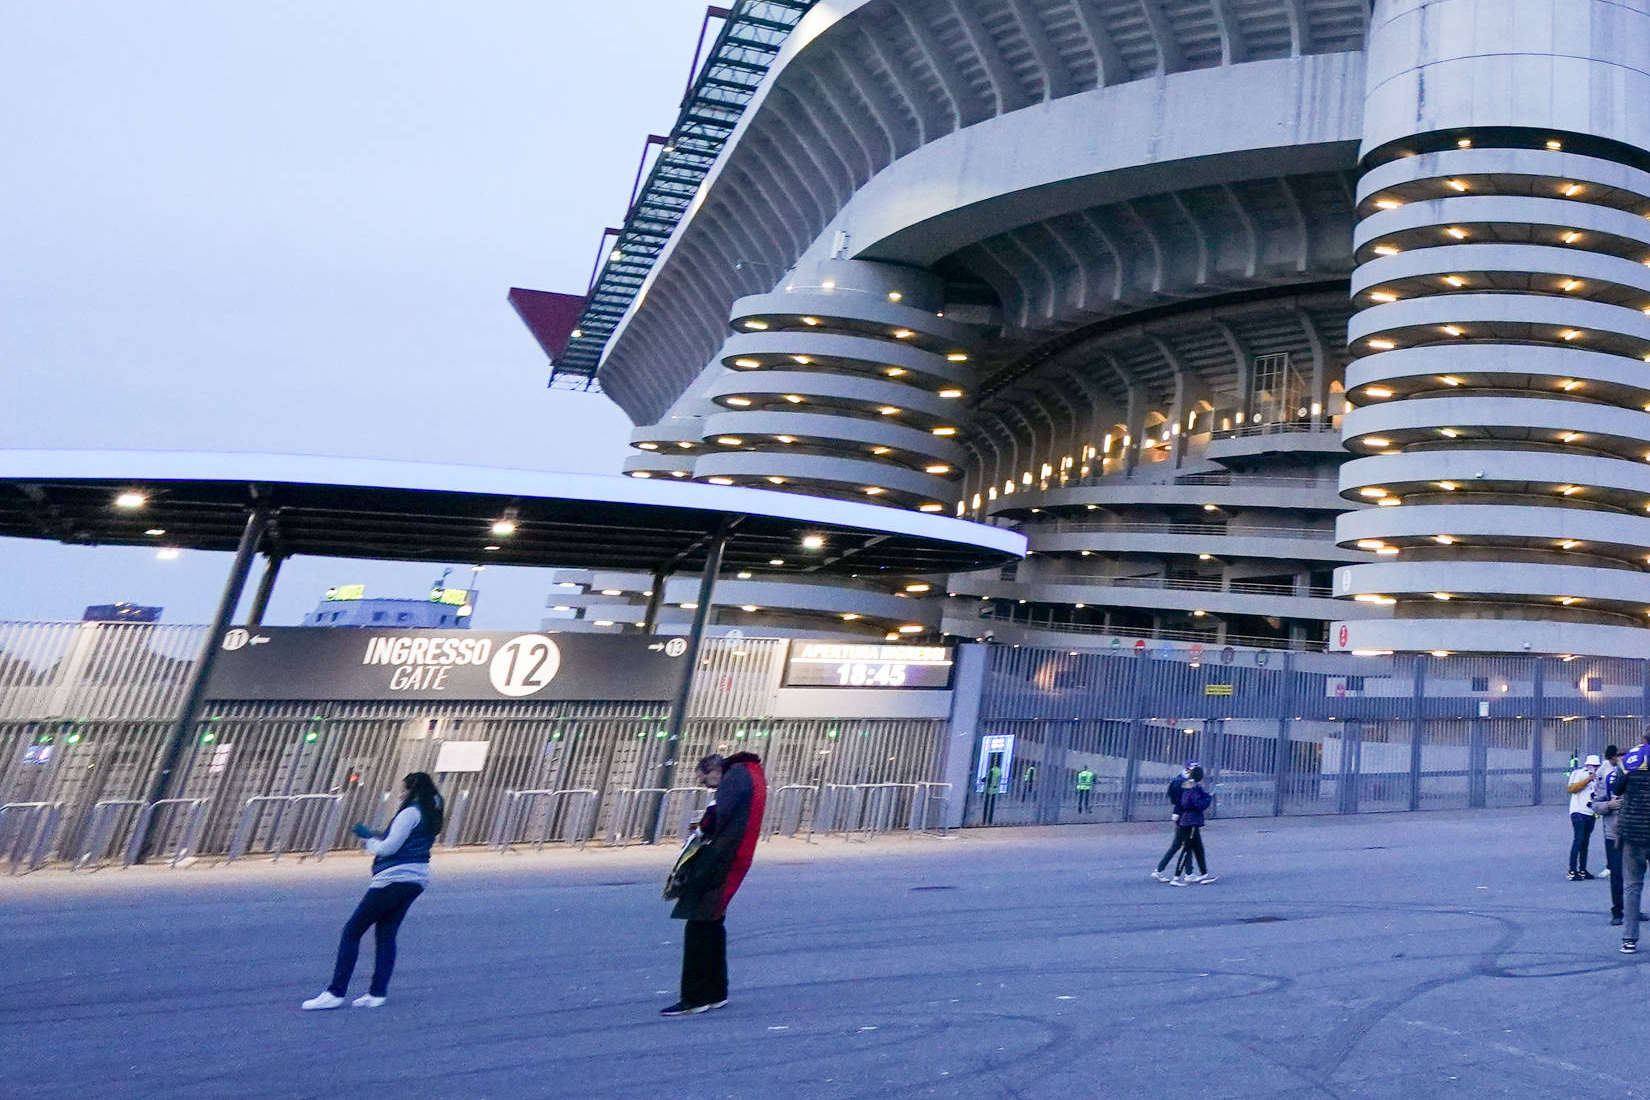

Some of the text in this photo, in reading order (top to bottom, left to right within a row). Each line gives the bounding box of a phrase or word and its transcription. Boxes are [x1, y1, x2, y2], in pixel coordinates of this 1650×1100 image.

[225, 631, 243, 648] 11
[363, 637, 493, 665] INGRESSO
[504, 643, 549, 687] 12
[837, 664, 906, 686] 18:45
[390, 666, 453, 691] GATE
